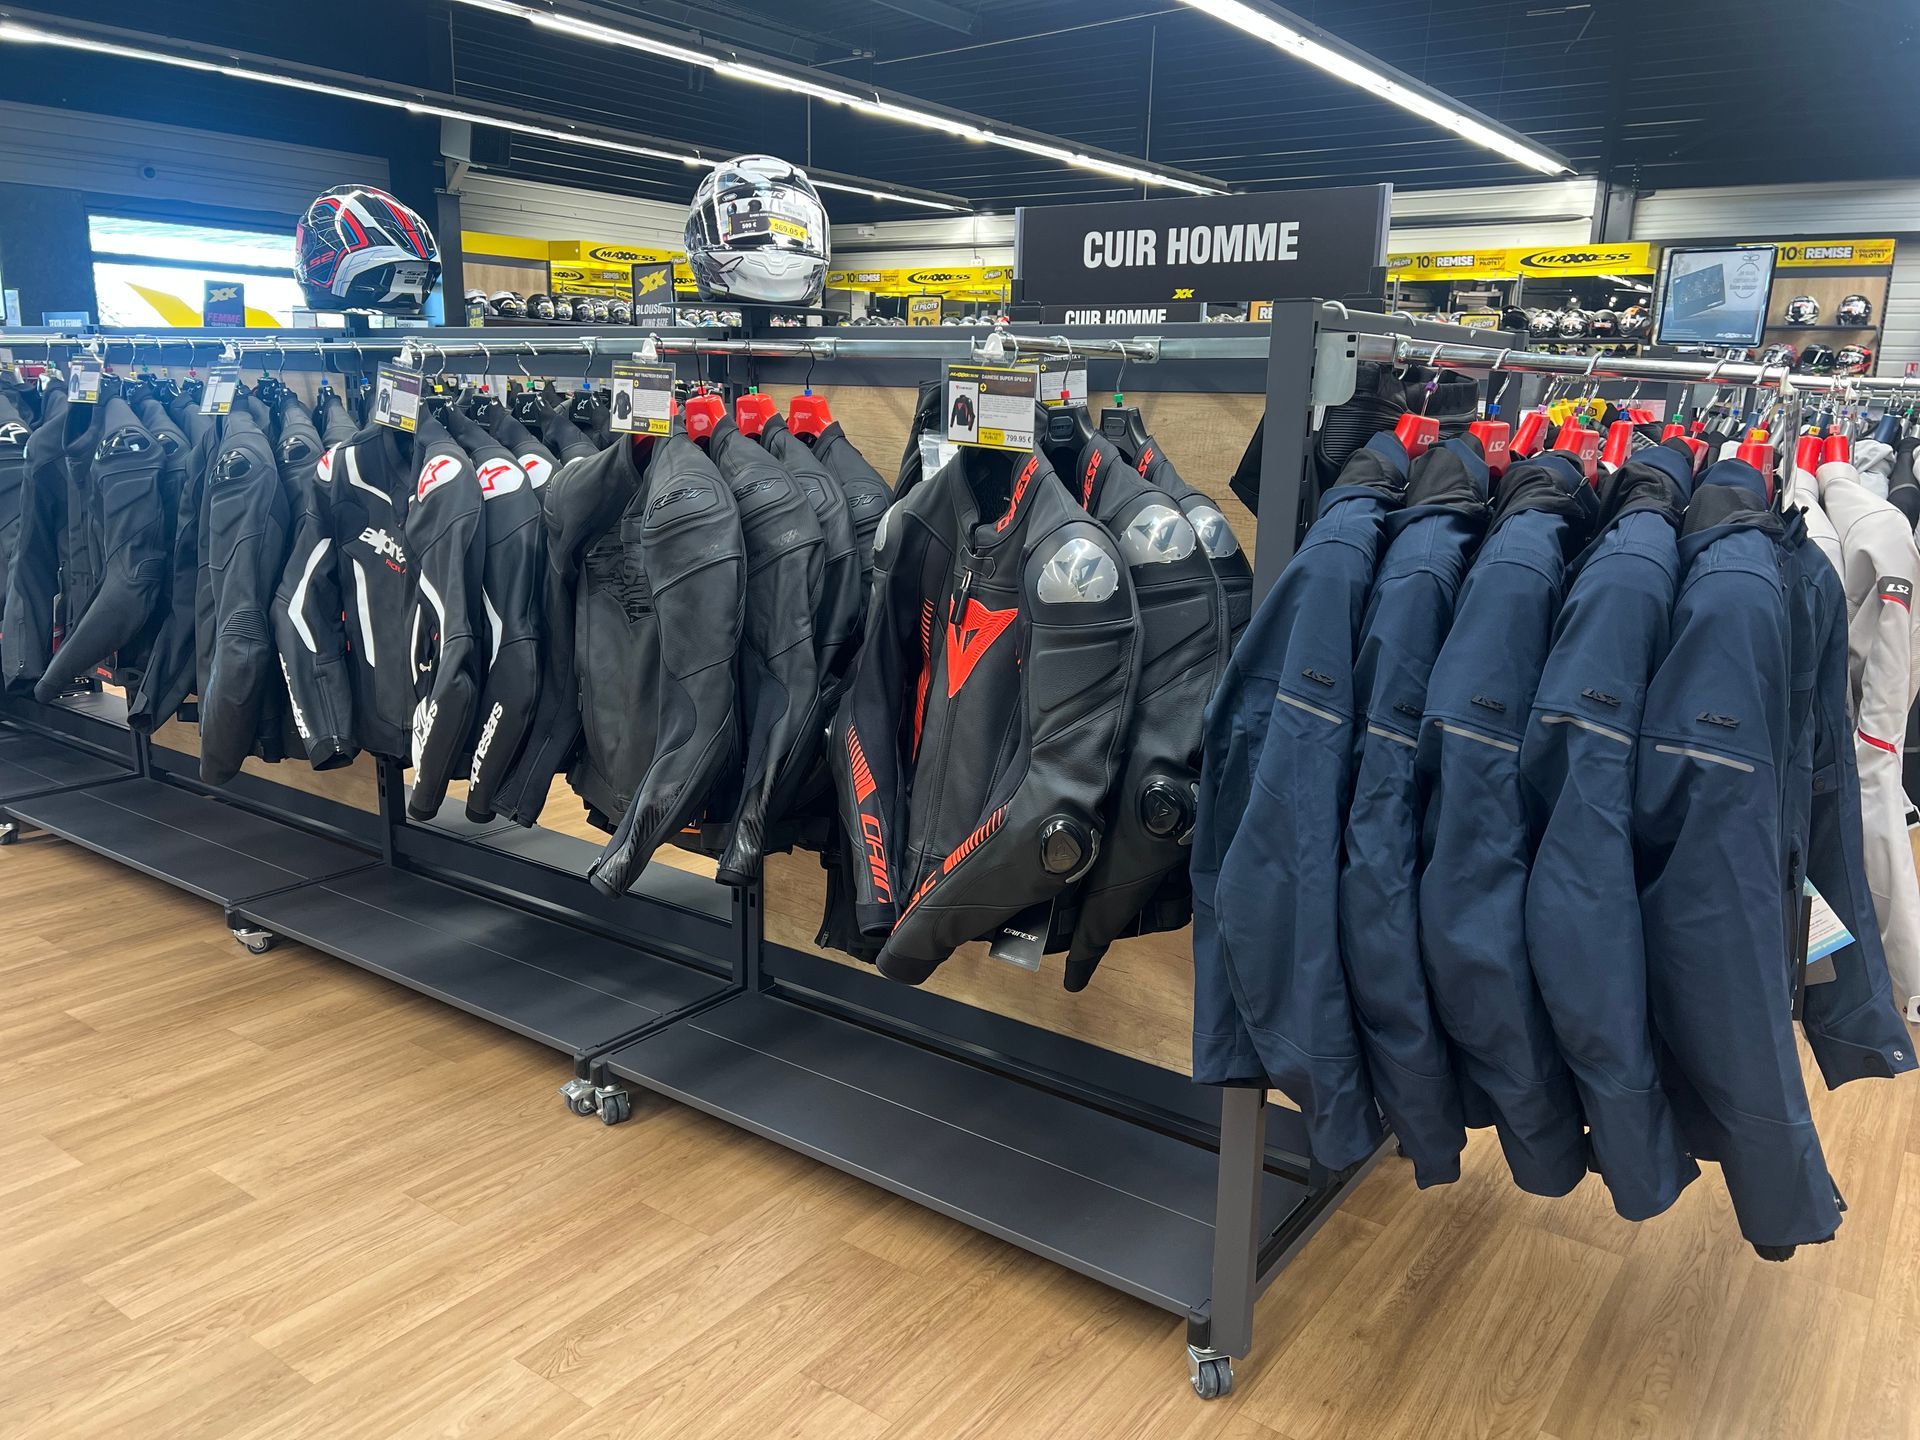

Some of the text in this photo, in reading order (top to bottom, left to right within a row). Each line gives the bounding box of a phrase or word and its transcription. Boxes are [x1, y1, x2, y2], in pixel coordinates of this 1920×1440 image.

[1083, 221, 1300, 269] CUIR HOMME
[600, 250, 657, 262] MAXXESS
[1538, 252, 1632, 263] MAXXESS
[1780, 247, 1797, 260] 10
[1806, 247, 1852, 259] REMISE
[1416, 255, 1430, 268] 10
[1436, 256, 1474, 267] REMISE
[858, 273, 880, 282] REMISE
[1065, 309, 1167, 325] CUIR HOMME
[1006, 435, 1026, 443] 799.95
[1417, 433, 1435, 445] LS2
[1488, 441, 1505, 452] LS2
[1581, 449, 1595, 461] LS2
[646, 485, 713, 523] RST
[1886, 582, 1910, 595] LS2
[1302, 667, 1336, 687] LS2
[1471, 692, 1507, 713] LS2
[1581, 687, 1621, 707] LS2
[1696, 711, 1743, 728] LS2
[1003, 927, 1039, 942] DAINESE
